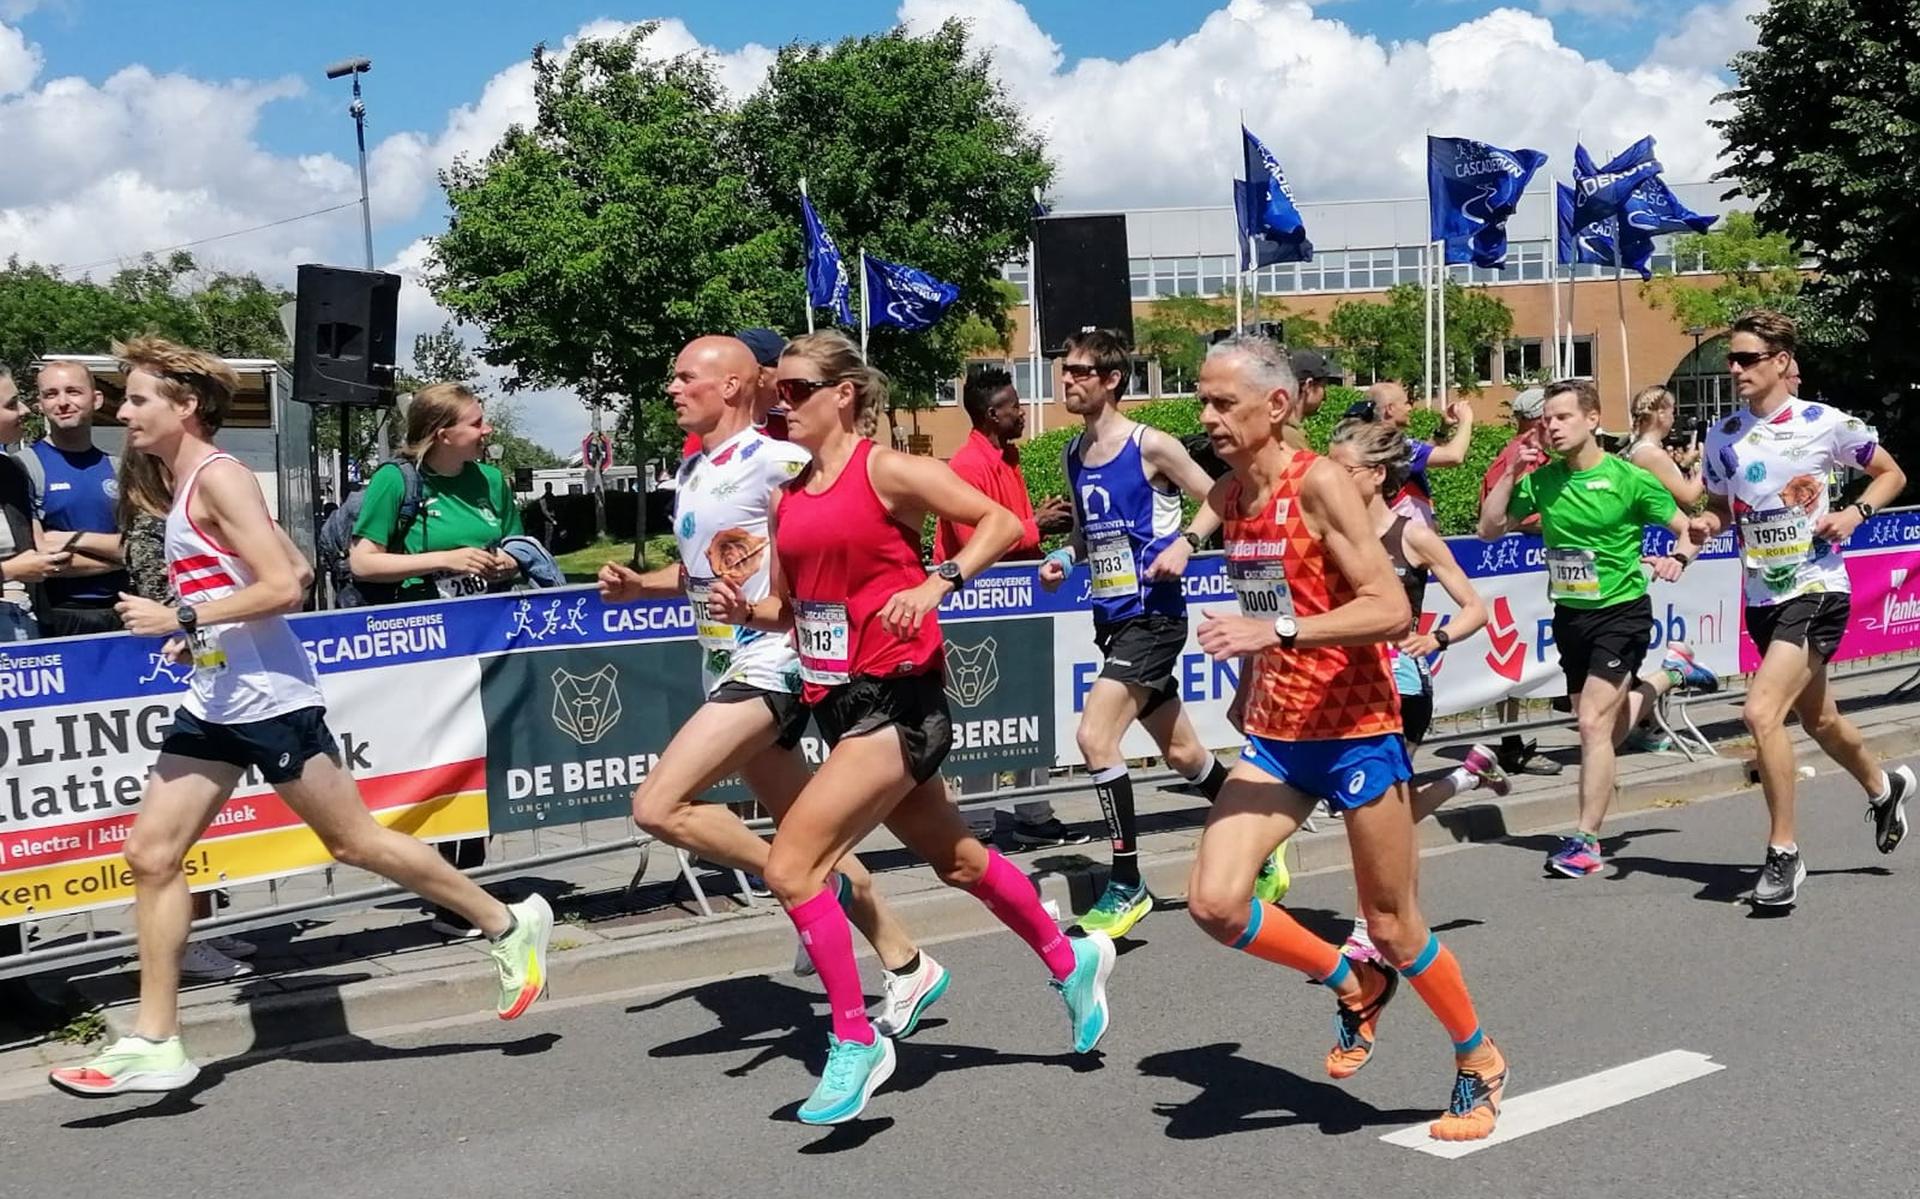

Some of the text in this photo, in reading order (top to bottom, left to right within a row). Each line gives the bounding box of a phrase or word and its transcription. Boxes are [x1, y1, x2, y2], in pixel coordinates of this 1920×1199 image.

[507, 765, 555, 800] DE
[509, 793, 613, 815] LUNCH DINNER
[11, 828, 82, 858] electra
